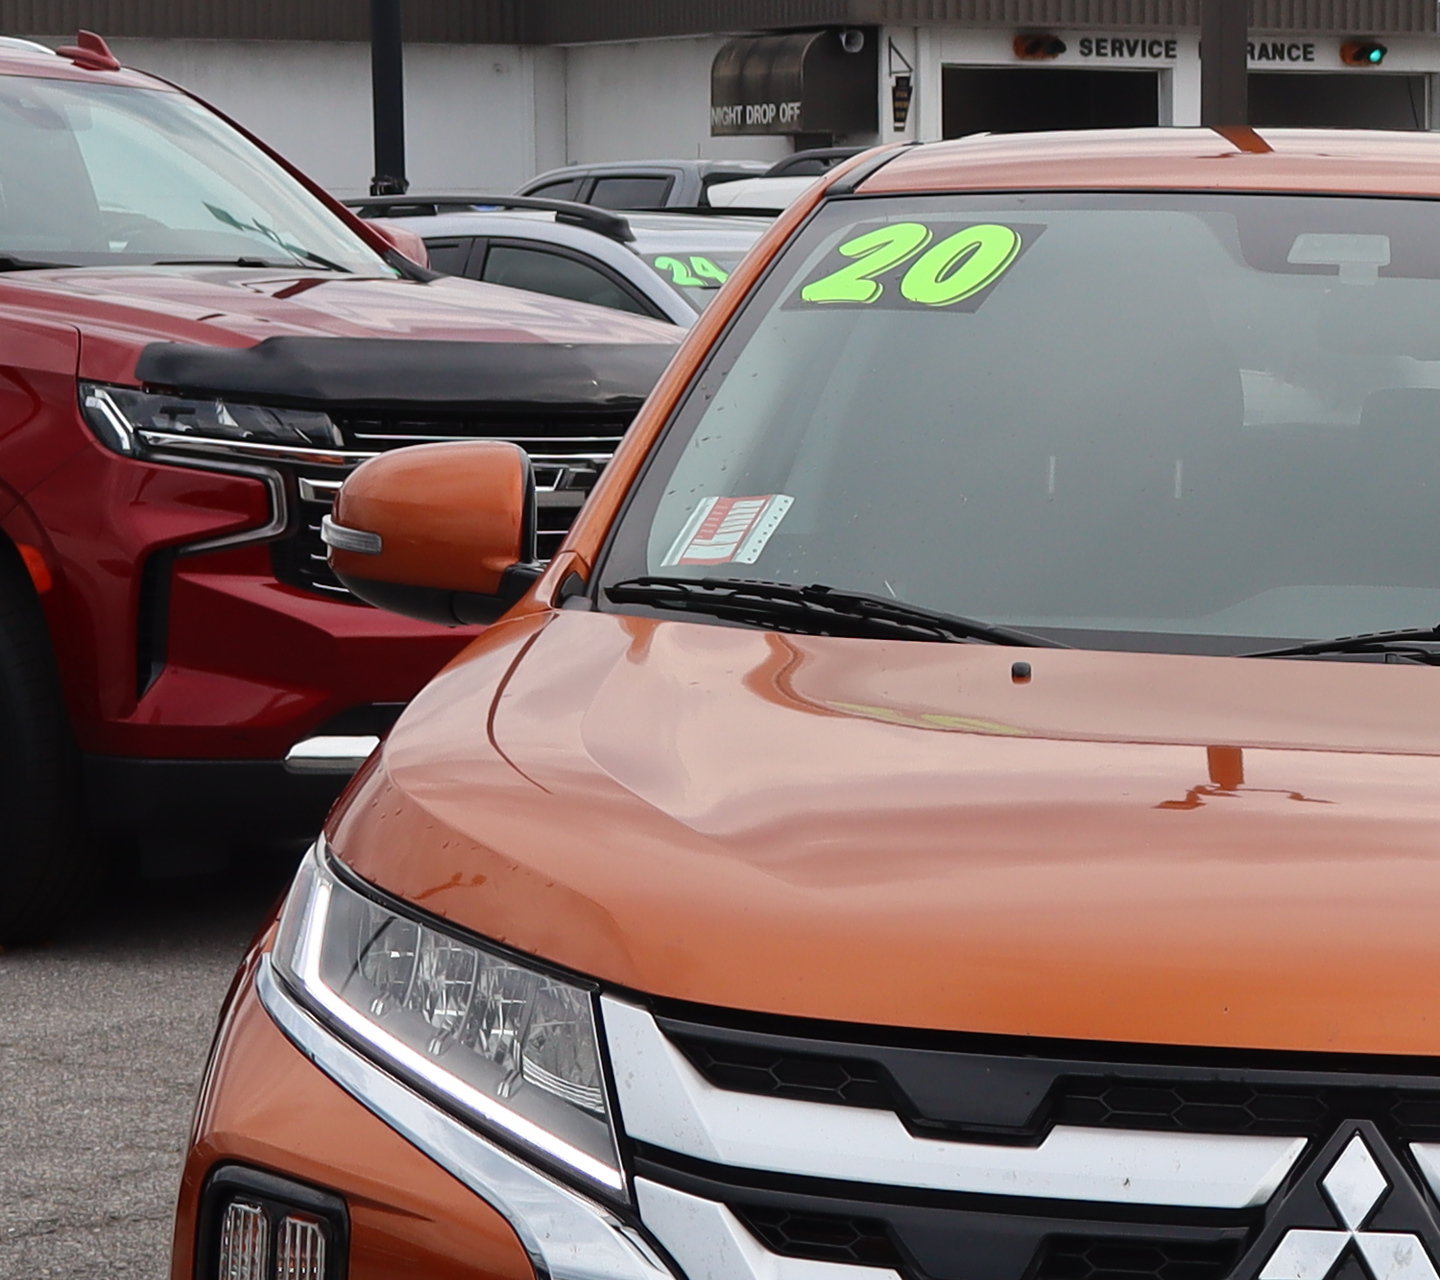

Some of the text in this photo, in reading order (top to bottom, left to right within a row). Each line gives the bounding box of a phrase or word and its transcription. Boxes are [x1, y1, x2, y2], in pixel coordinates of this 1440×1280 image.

[1079, 38, 1178, 59] SERVICE
[712, 101, 802, 127] NIGHT DROP OFF
[655, 256, 729, 288] 24
[801, 222, 1023, 307] 20
